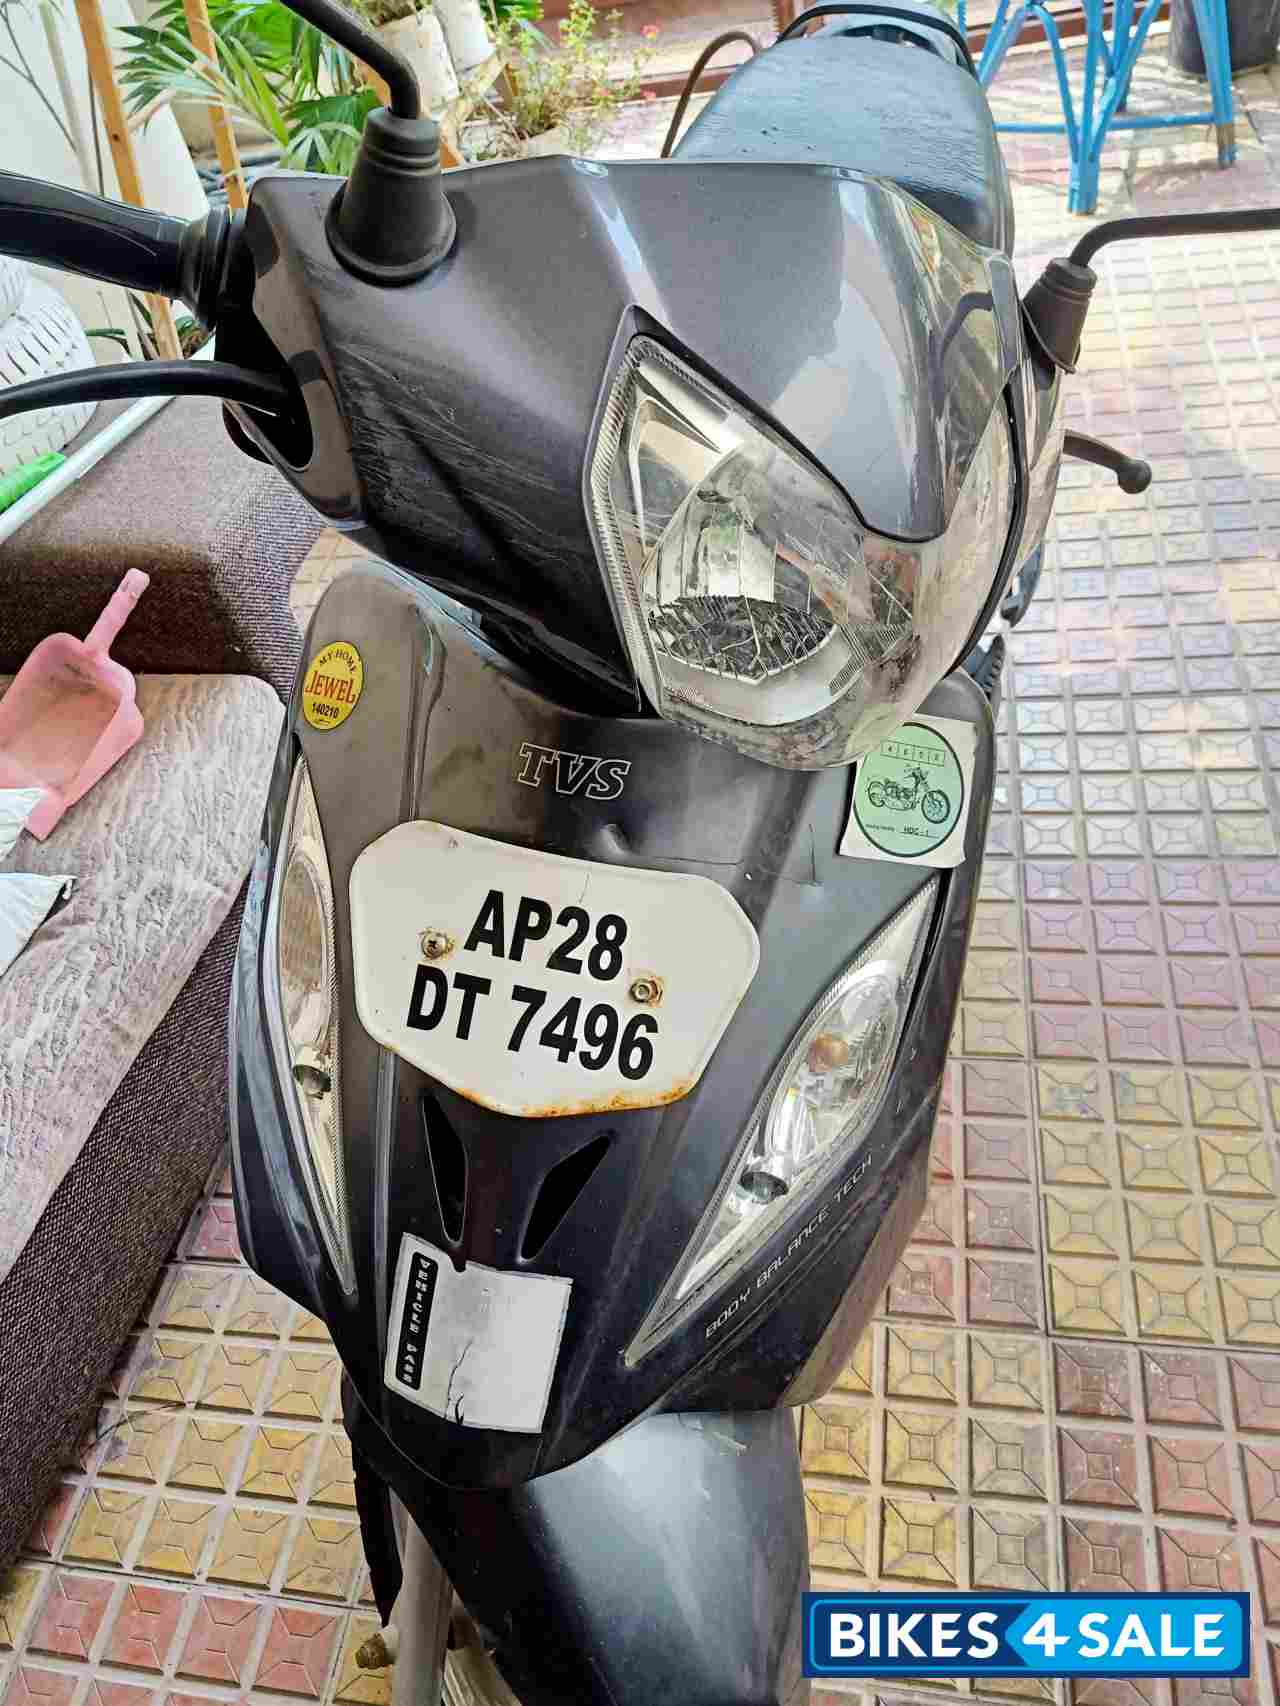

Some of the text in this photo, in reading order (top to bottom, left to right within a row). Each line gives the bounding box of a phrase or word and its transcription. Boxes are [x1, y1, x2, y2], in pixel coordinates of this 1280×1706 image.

[304, 670, 356, 704] JEWEL
[518, 742, 632, 801] TVS
[463, 889, 628, 981] AP28
[406, 963, 659, 1081] DT 7496
[705, 1153, 872, 1339] BODY BALANCE TECH
